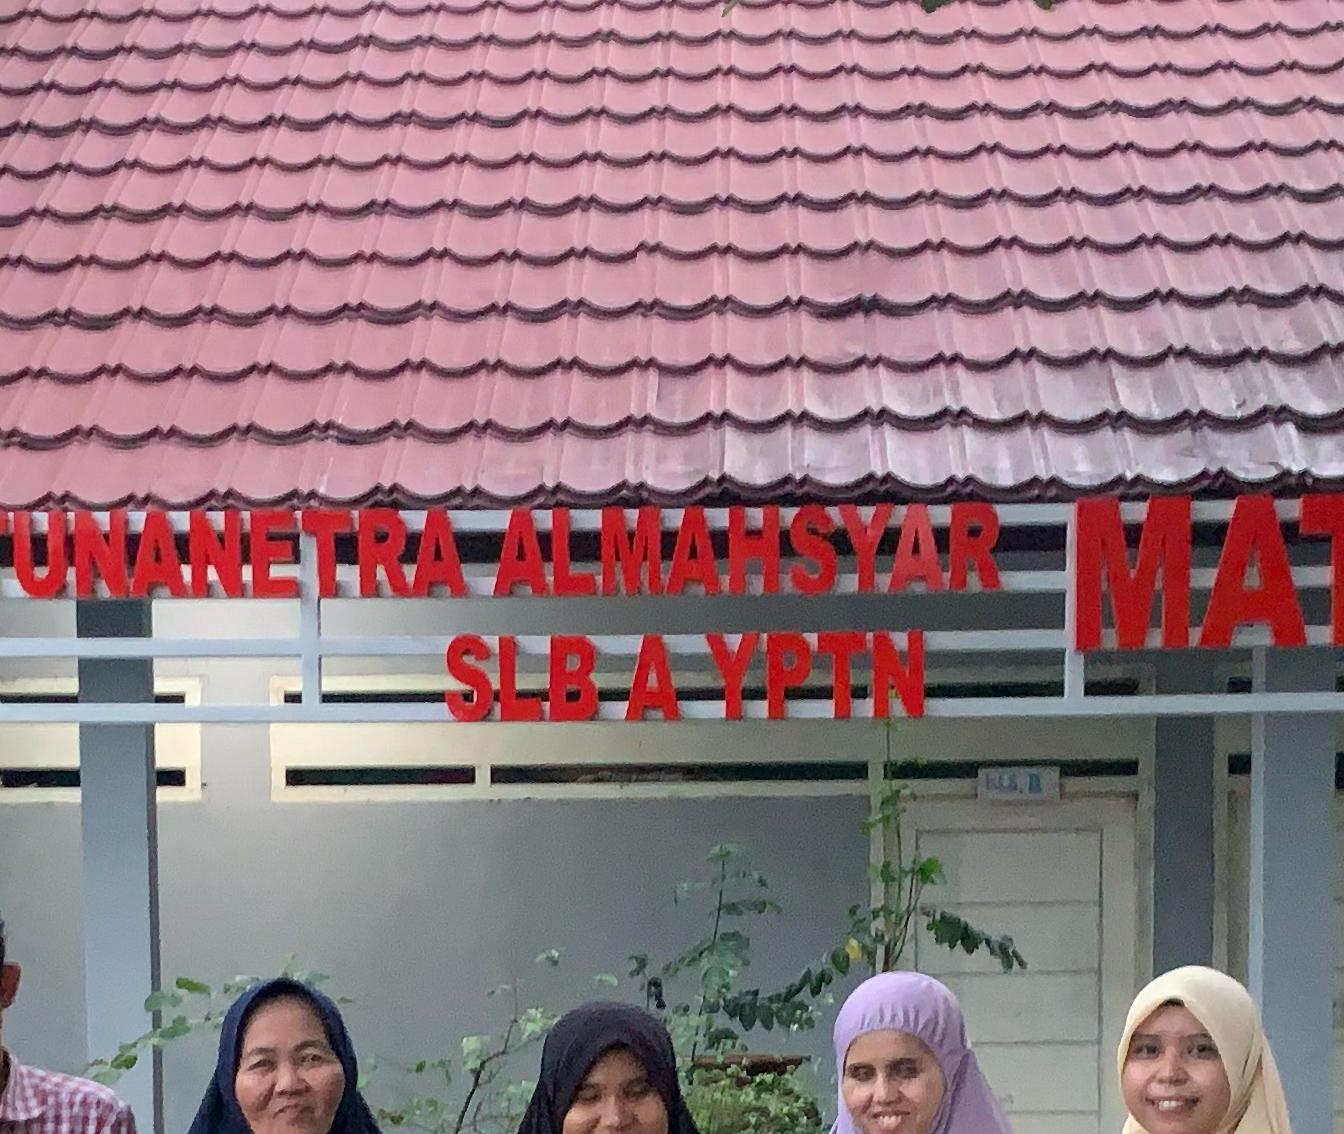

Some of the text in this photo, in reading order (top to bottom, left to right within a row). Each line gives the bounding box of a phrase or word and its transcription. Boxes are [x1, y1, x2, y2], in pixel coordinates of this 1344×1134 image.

[492, 502, 1001, 596] ALMAHSYAR
[444, 629, 925, 723] SLB A YPTN
